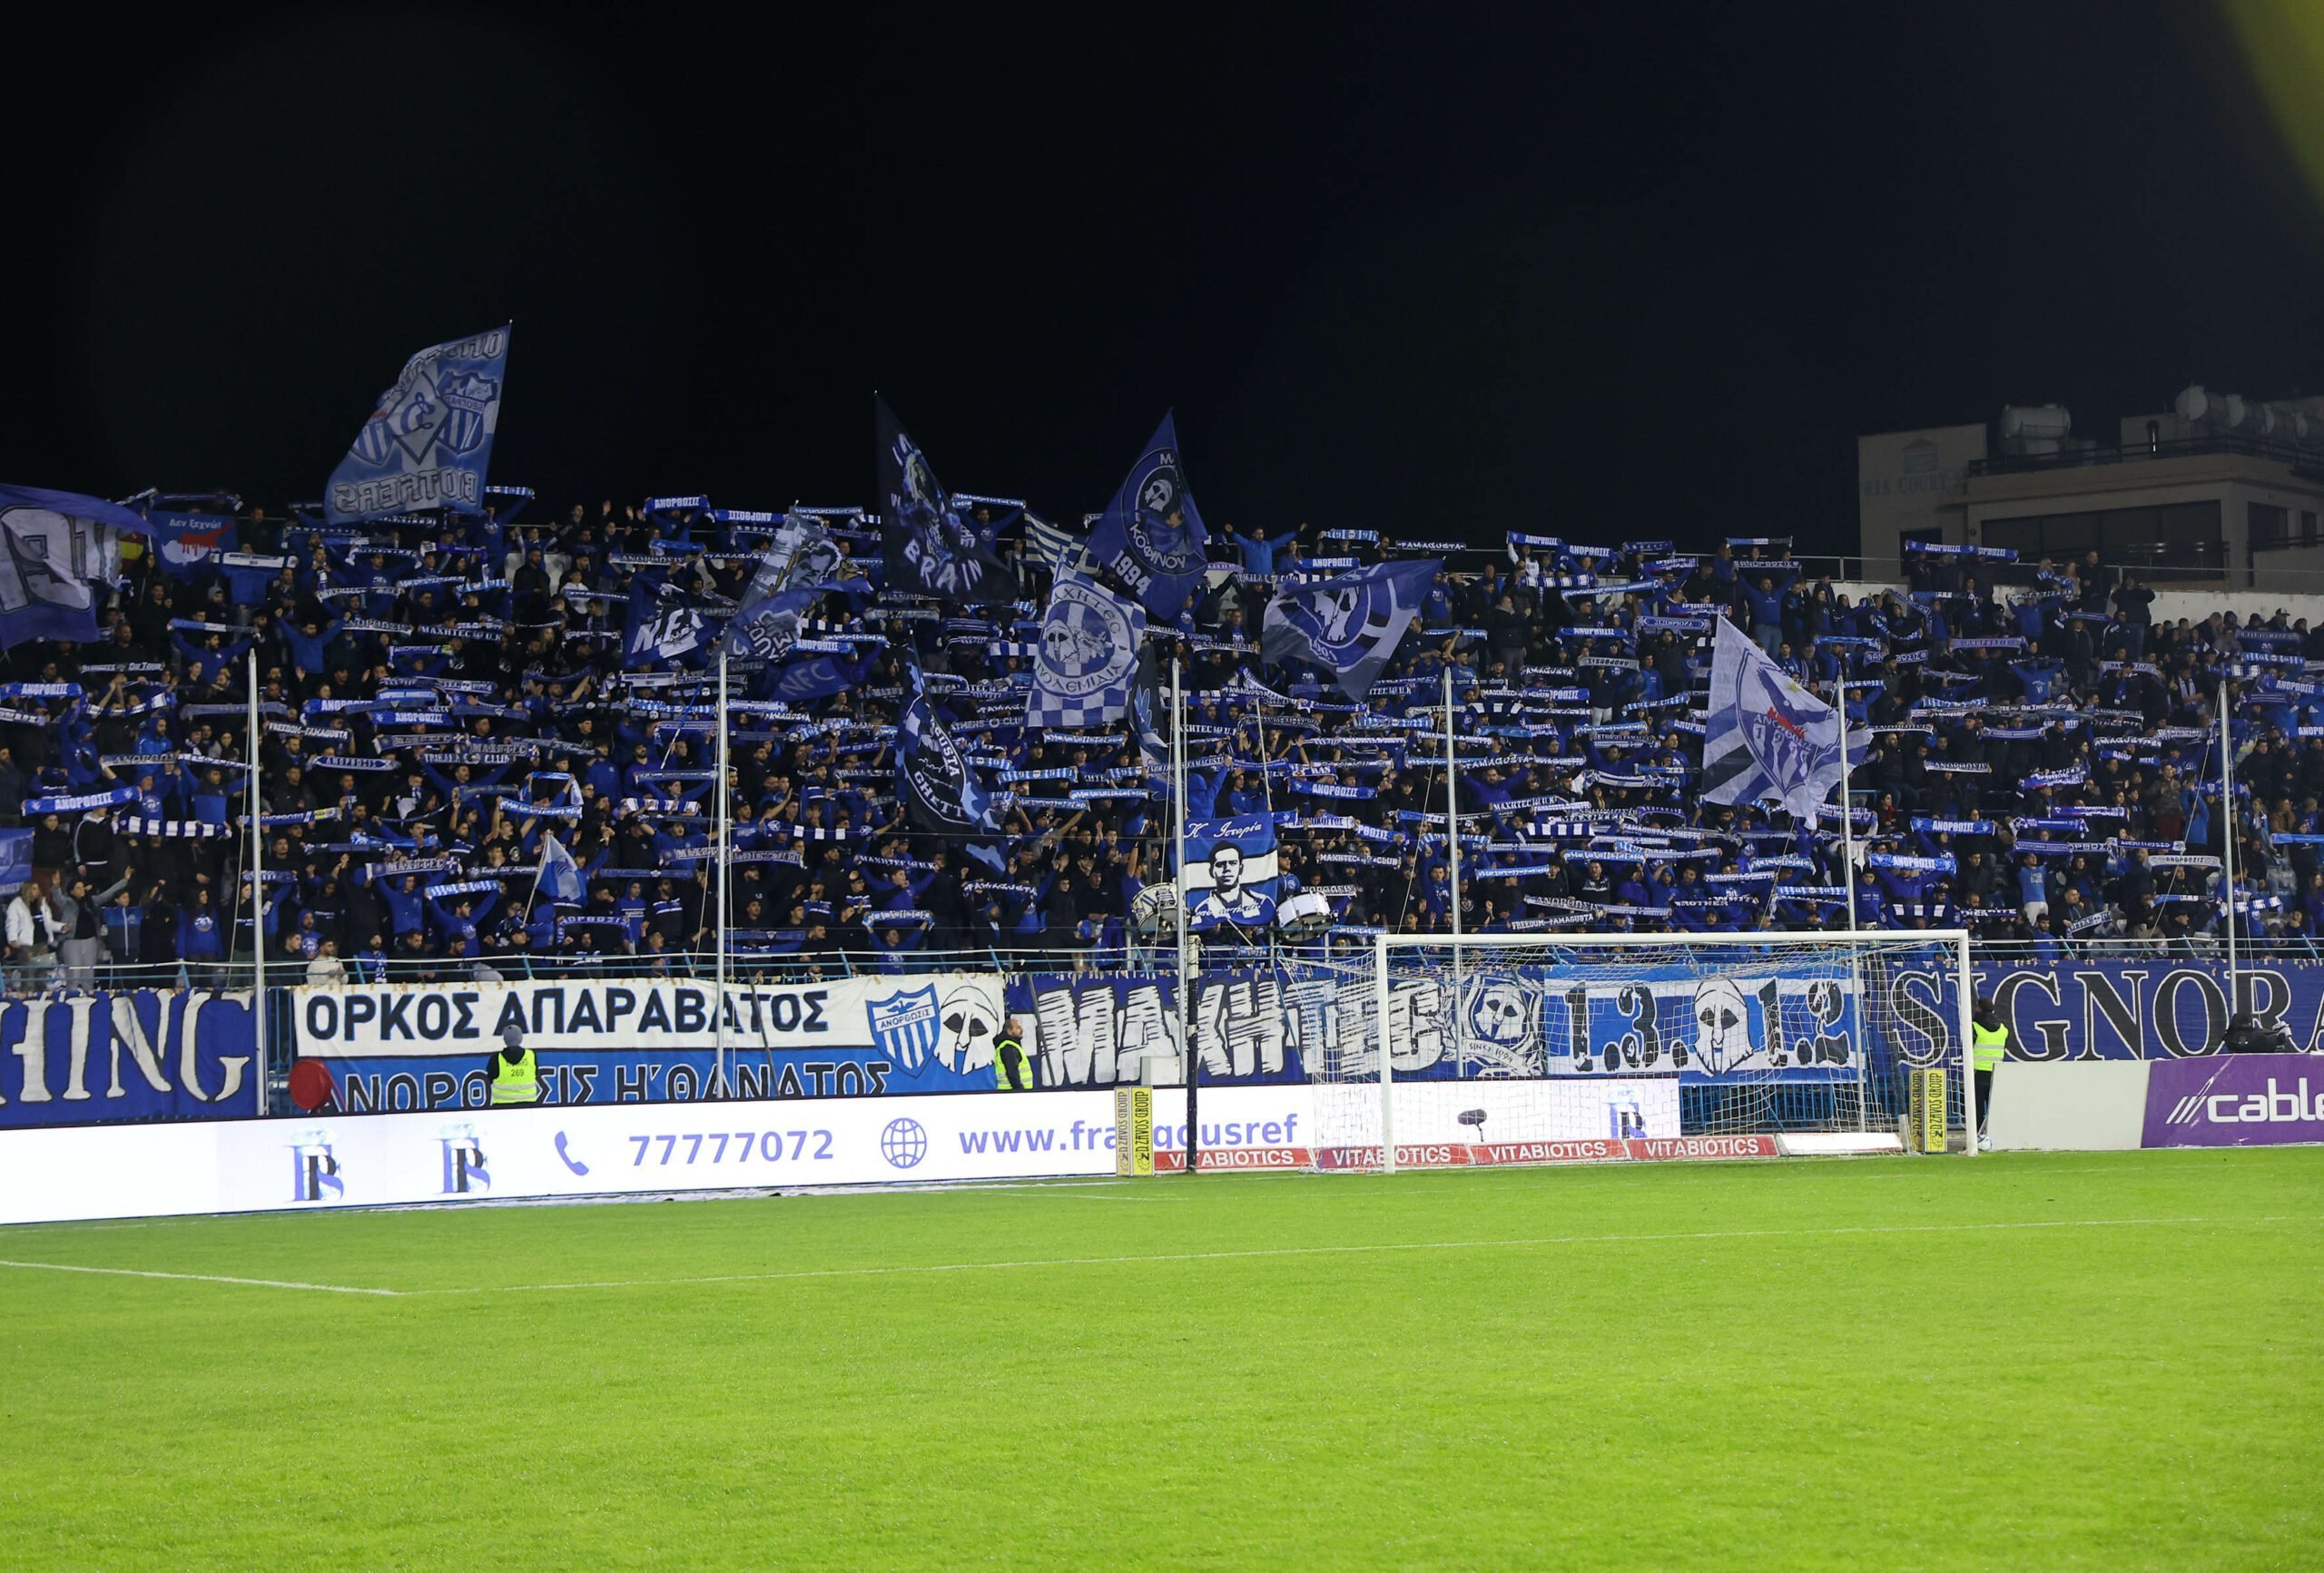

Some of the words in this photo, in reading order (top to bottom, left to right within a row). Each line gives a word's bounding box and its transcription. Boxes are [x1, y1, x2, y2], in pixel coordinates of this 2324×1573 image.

[655, 496, 701, 509] ΑΝΟΡΘΩΣΙΣ
[1569, 544, 1611, 557] ΑΝΟΡΘΩΣΙΣ
[1109, 549, 1152, 596] 1994
[1313, 557, 1354, 568] ΑΝΟΡΘΩΣΙΣ
[2275, 678, 2316, 694] ΑΝΟΡΘΩΣΙΣ
[54, 792, 113, 811] ΑΝΟΡΘΩΣΙΣ
[913, 771, 966, 819] GHETT
[1312, 785, 1359, 799] ΑΝΟΡΘΩΣΙΣ
[1932, 820, 1974, 833] ΑΝΟΡΘΩΣΙΣ
[1892, 855, 1936, 870] ΑΝΟΡΘΩΣΙΣ
[306, 992, 480, 1041] ΟΡΚΟΣ
[493, 987, 829, 1037] ΑΠΑΡΑΒΑΤΟΣ
[880, 1008, 931, 1028] ΑΝΟΡΘΩΣΙΣ
[1890, 969, 2324, 1068] SIGNOR
[308, 1065, 599, 1114] ΝΟΡΘΣΙΣ
[1928, 1072, 1943, 1098] GROUP
[1134, 1090, 1149, 1118] GROUP
[1928, 1099, 1943, 1124] ZAVOS
[960, 1113, 1298, 1153] www.fragousref
[1134, 1119, 1149, 1145] ZAVOS
[628, 1128, 834, 1167] 77777072
[1332, 1146, 1452, 1165] VITABOTICS
[1489, 1141, 1608, 1162] VITABIOTICS
[1644, 1137, 1759, 1157] VITABIOTICS
